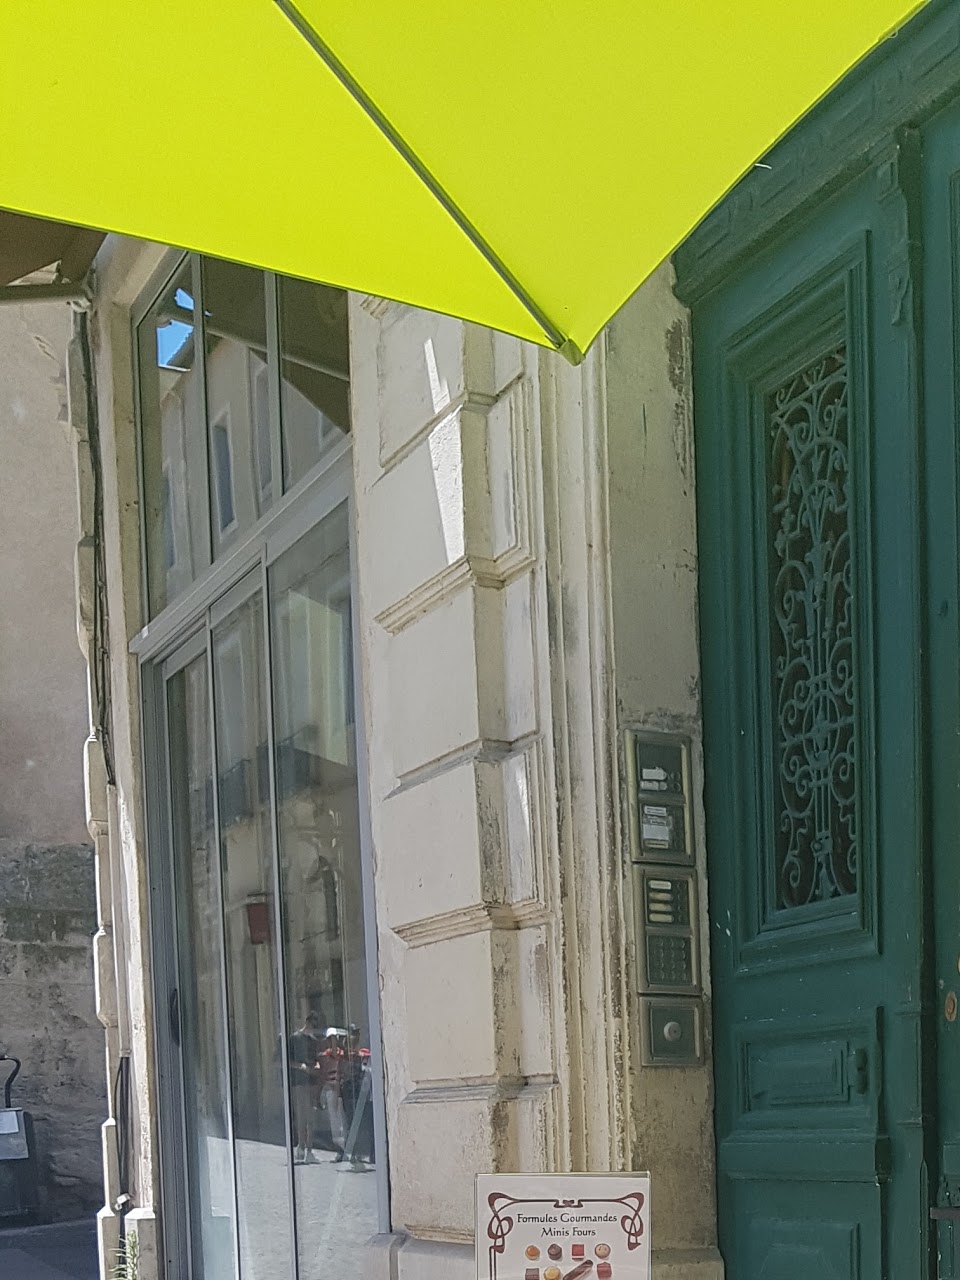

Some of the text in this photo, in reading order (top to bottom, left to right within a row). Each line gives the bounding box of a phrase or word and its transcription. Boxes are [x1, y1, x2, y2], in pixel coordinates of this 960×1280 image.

[517, 1213, 617, 1223] Formules Gourmandes
[541, 1227, 596, 1238] Minis Fours
